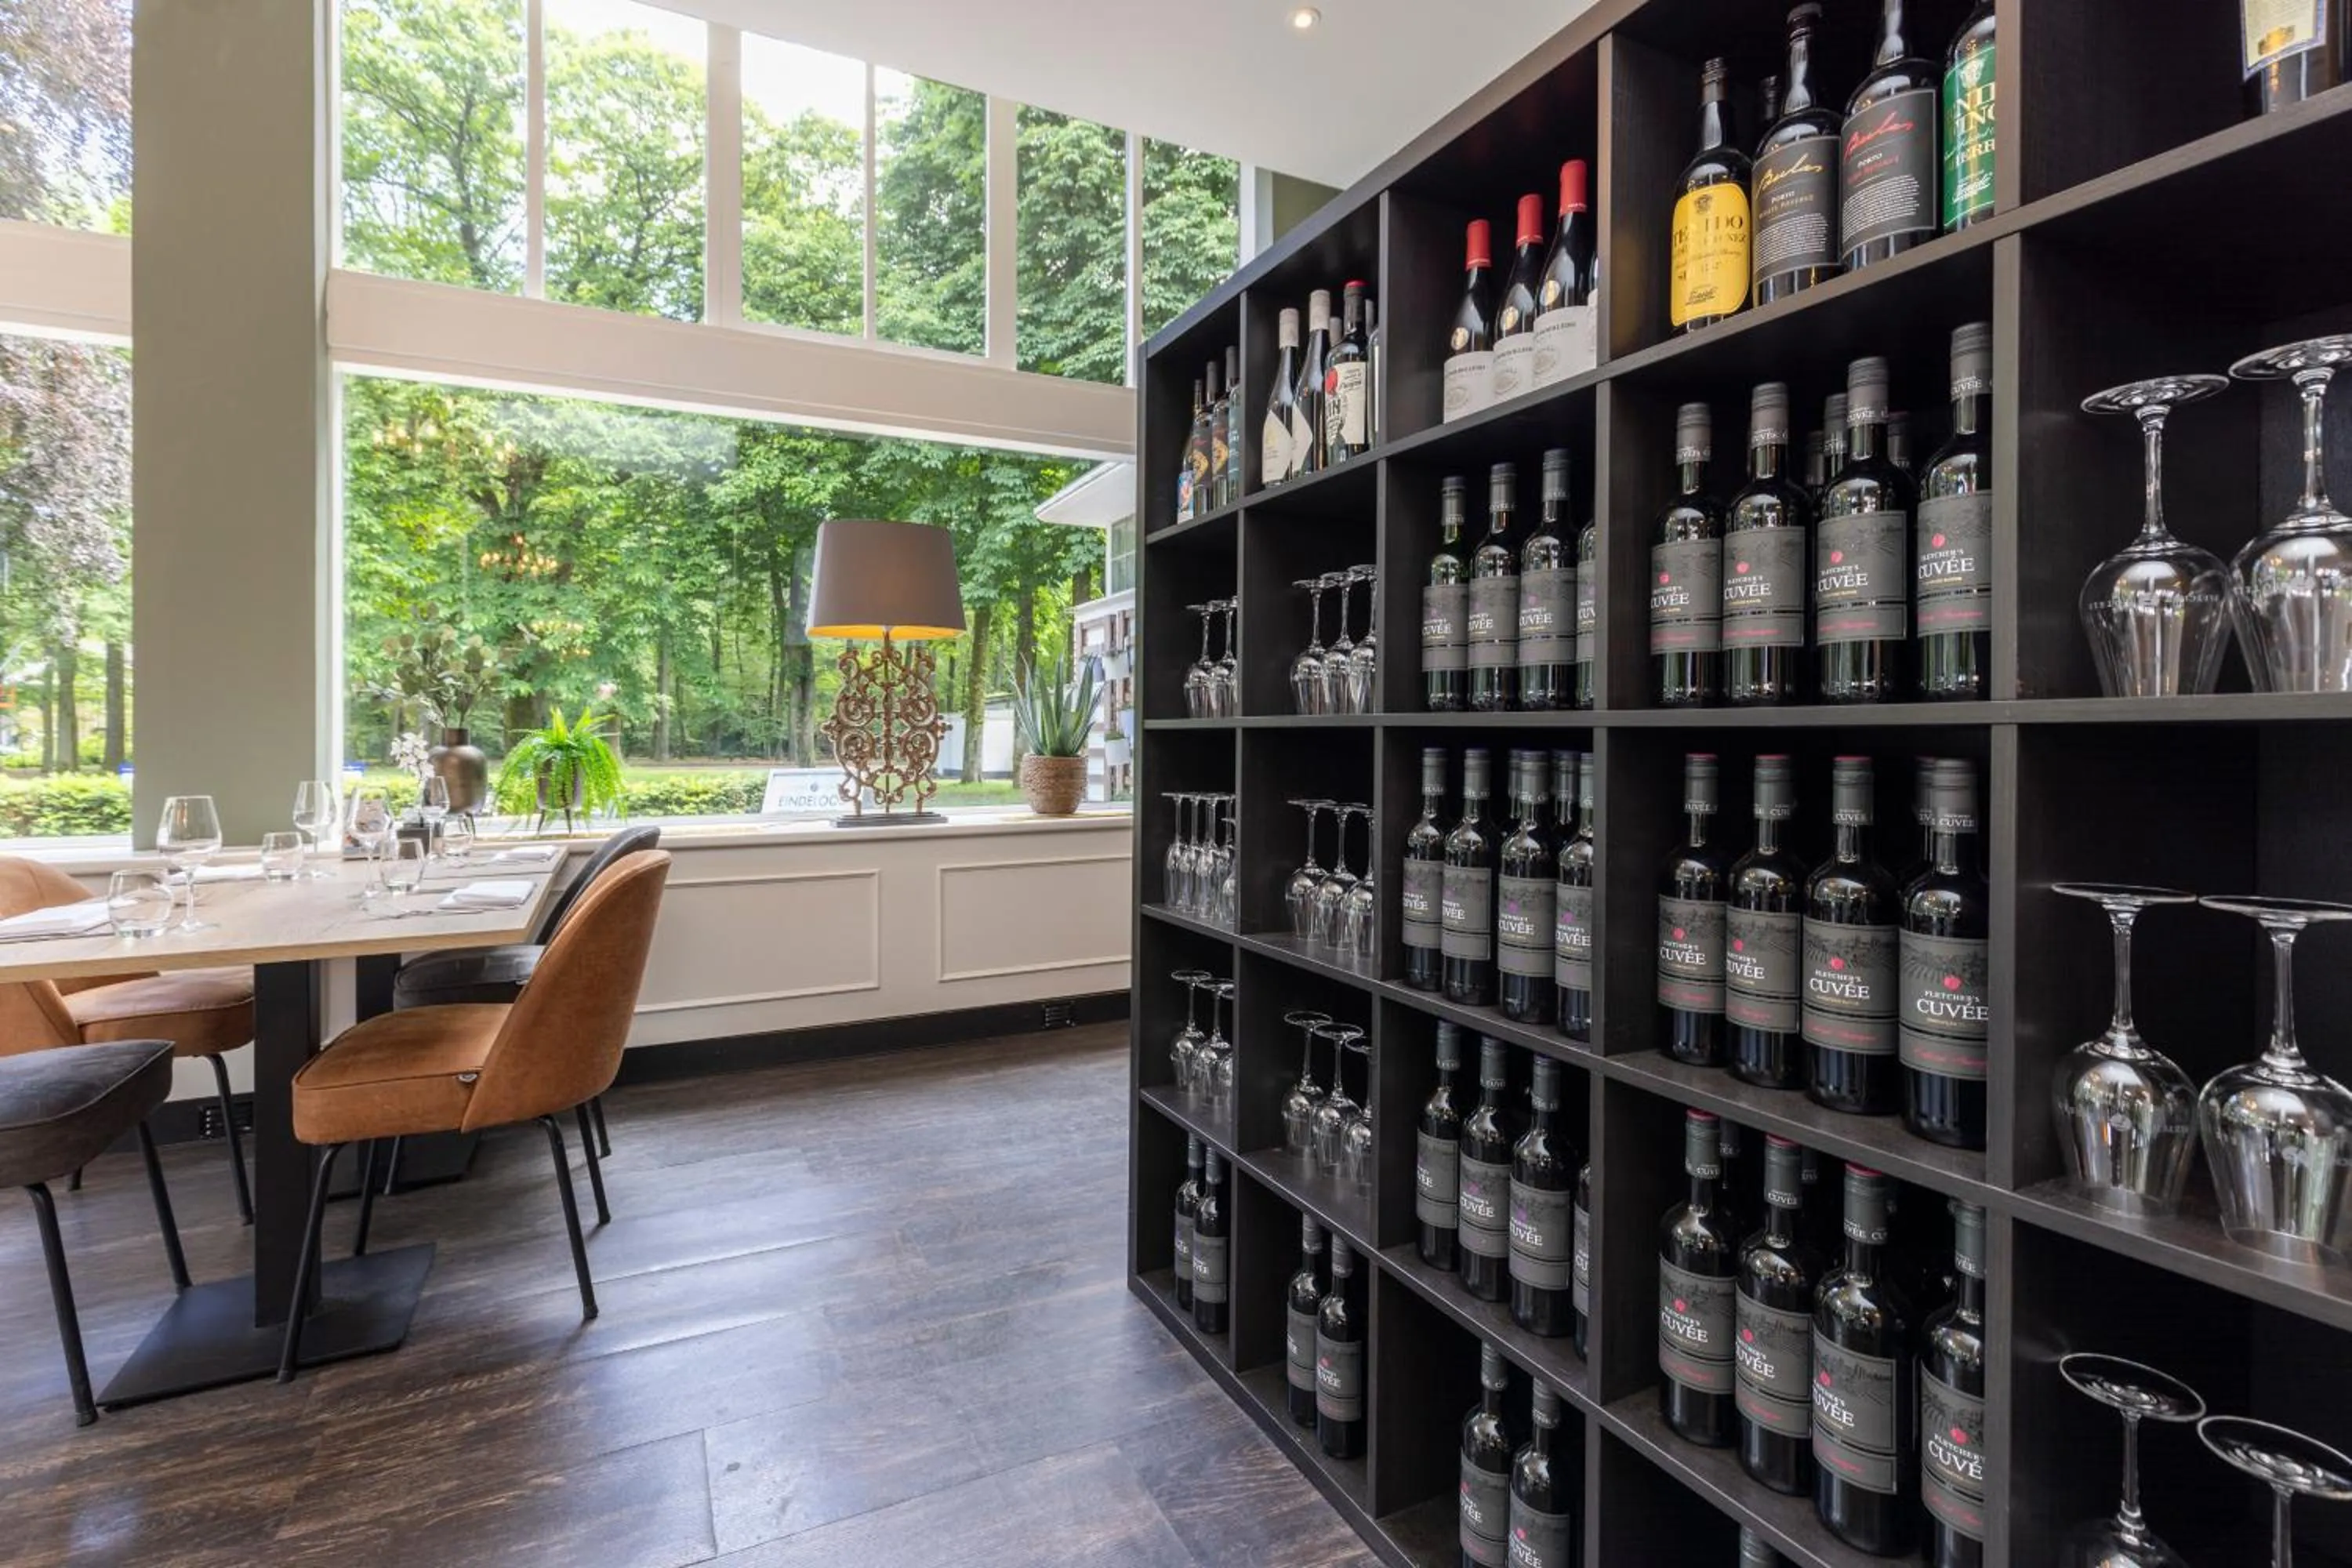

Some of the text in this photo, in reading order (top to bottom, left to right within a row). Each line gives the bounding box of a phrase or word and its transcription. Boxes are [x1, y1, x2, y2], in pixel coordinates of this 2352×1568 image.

[1659, 946, 1708, 966] CUVÉE
[1809, 977, 1871, 1000] CUVÉE
[1923, 990, 1981, 1004] FLETCHER'S
[1915, 998, 1989, 1021] CUVÉE
[1661, 1312, 1708, 1343] CUVÉE
[1928, 1440, 1984, 1481] CUVÉ
